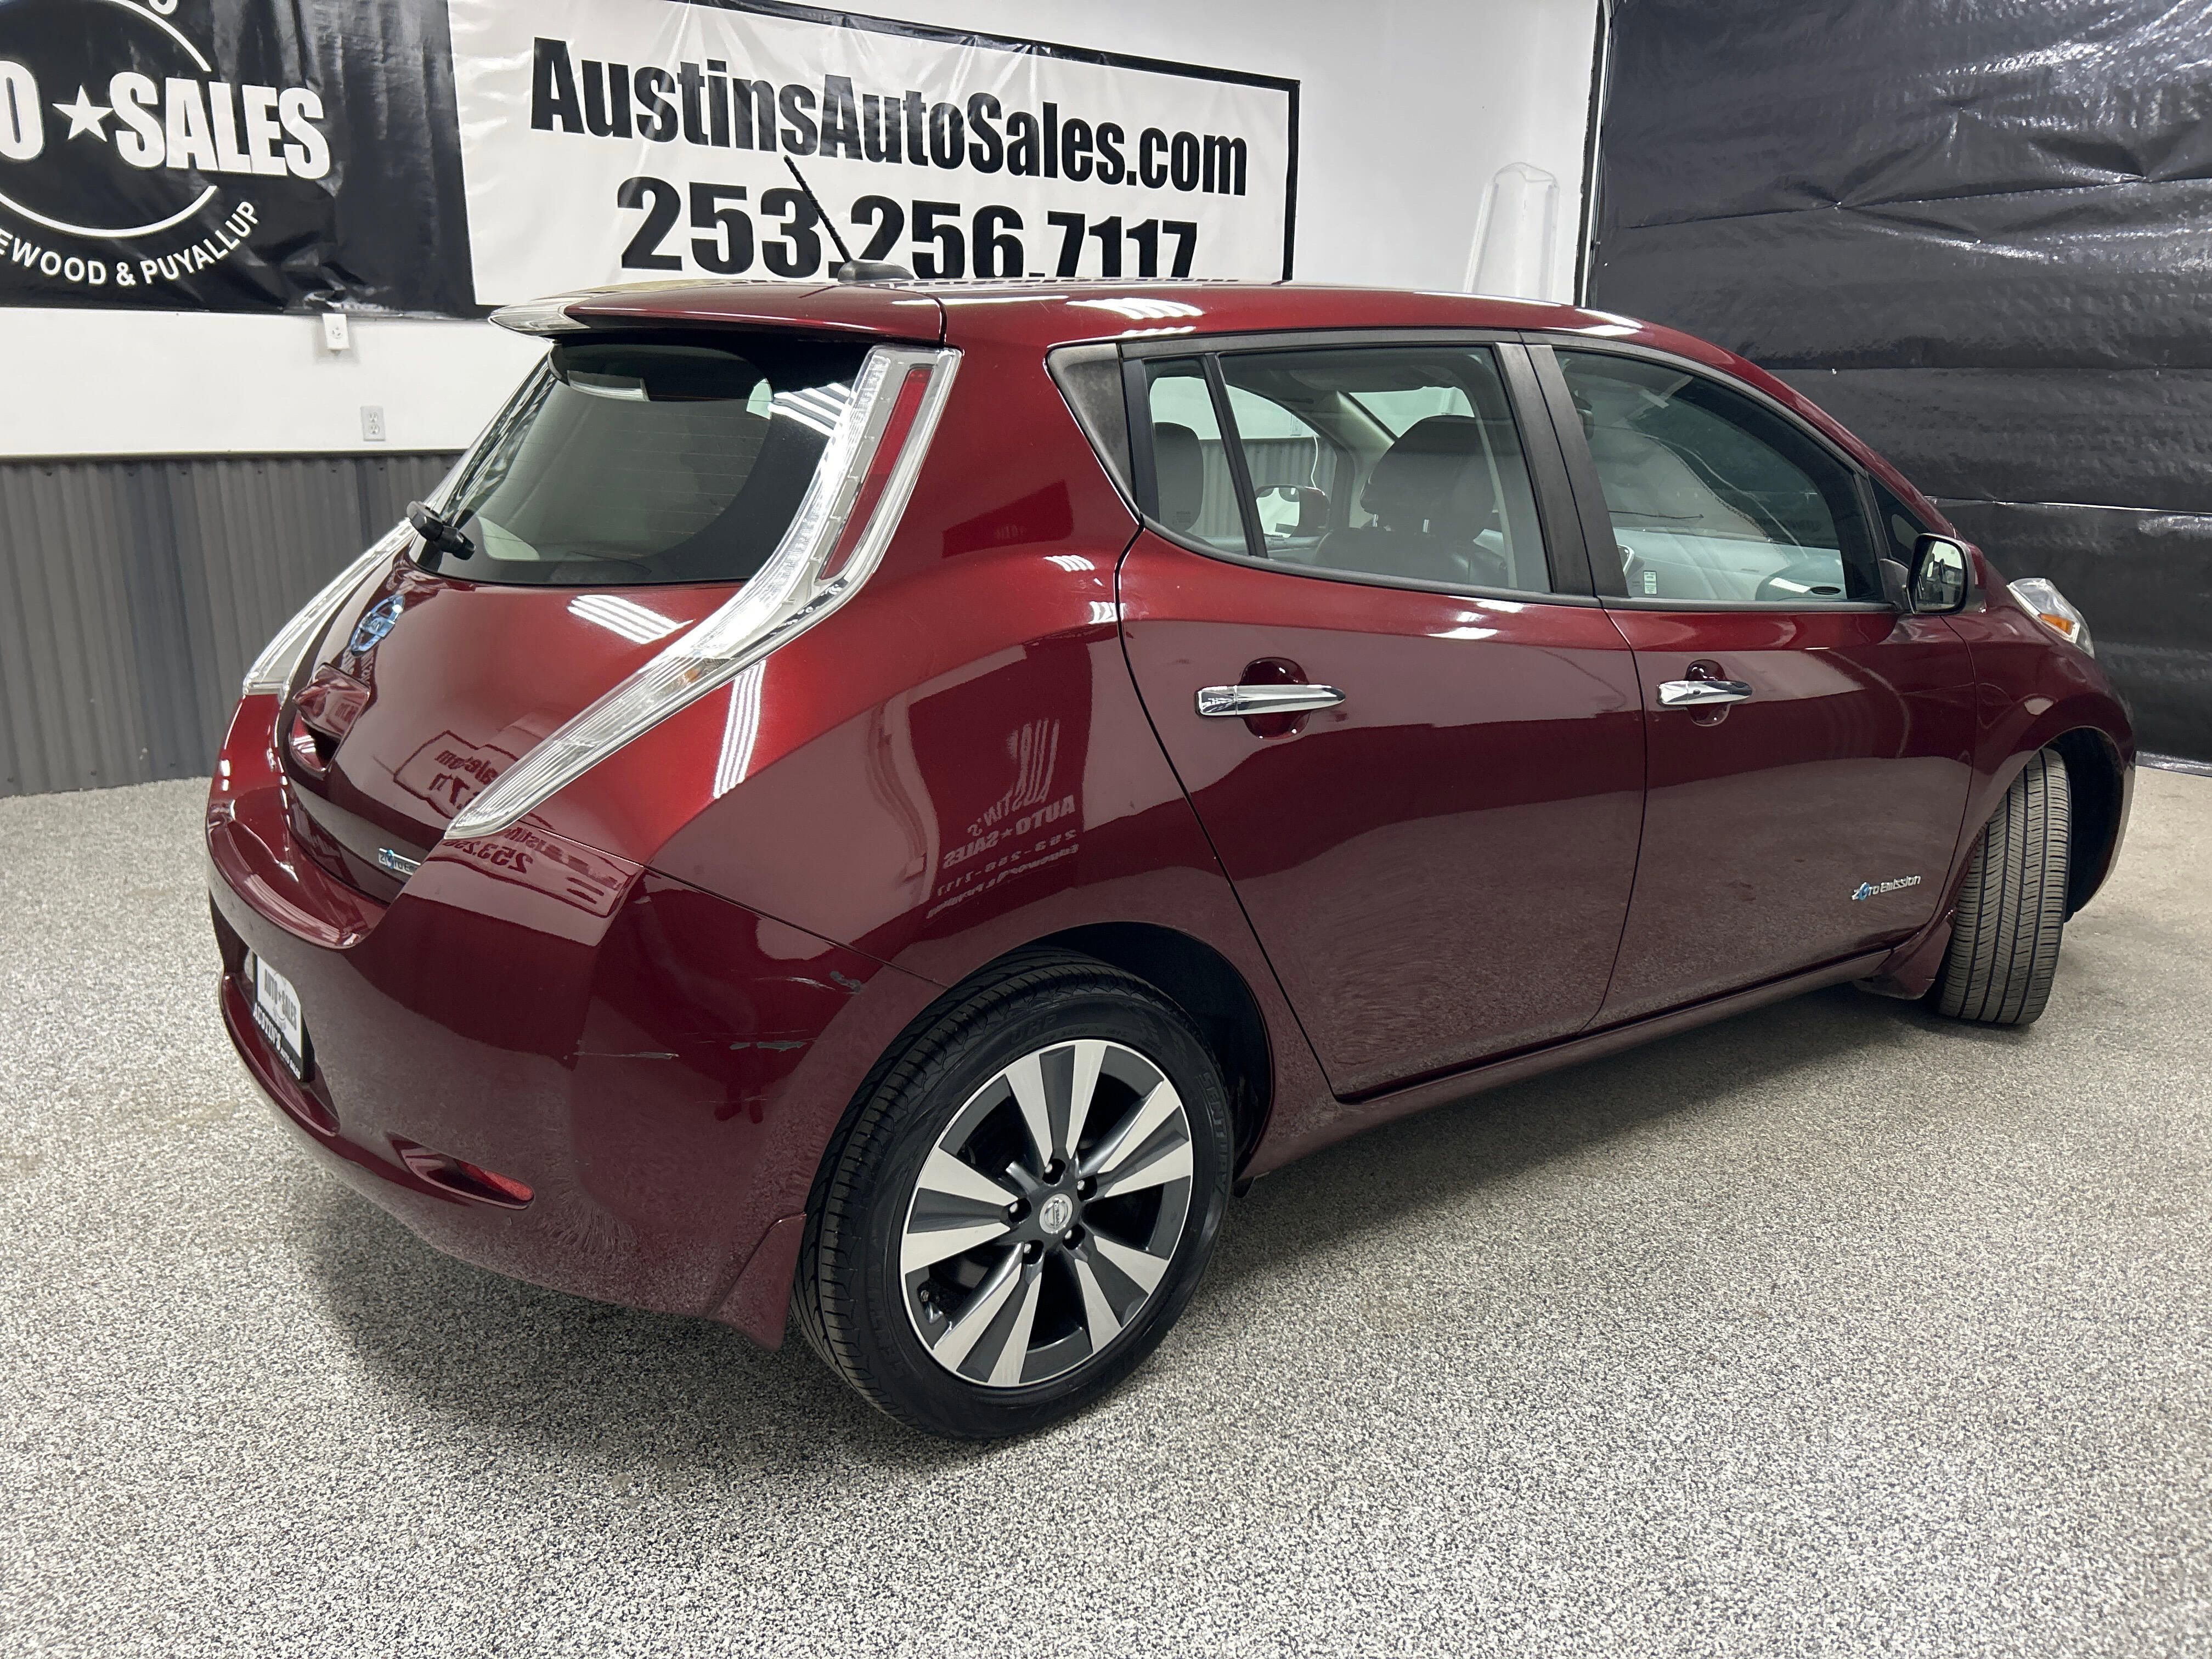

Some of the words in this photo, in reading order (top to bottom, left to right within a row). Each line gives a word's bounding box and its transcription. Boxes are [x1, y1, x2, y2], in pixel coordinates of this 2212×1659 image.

[110, 71, 331, 179] SALES
[531, 36, 1247, 196] AustinsAutoSales.com
[116, 262, 137, 286] &
[140, 201, 258, 284] PUYALLUP
